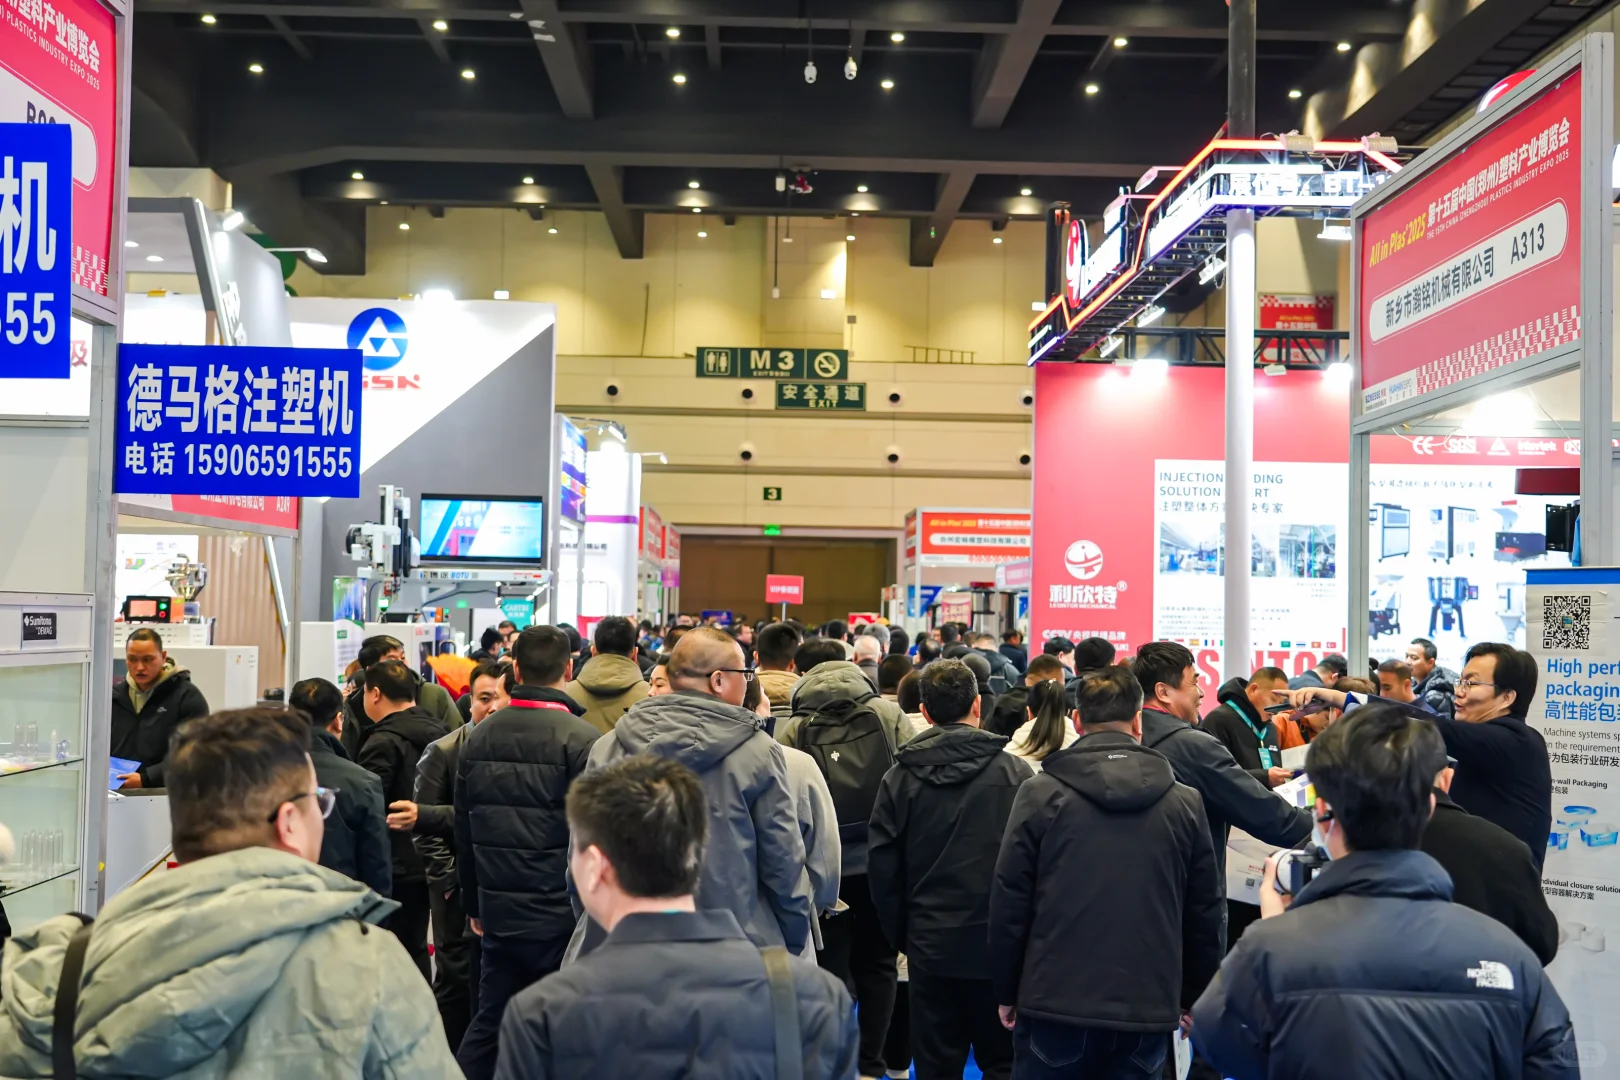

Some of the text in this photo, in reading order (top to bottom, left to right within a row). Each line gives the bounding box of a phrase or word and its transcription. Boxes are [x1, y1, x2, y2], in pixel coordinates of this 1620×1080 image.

[6, 0, 100, 73] 塑料产业博览会
[6, 10, 37, 43] PLASTICS
[38, 35, 68, 66] INDUSTRY
[70, 59, 85, 78] EXPO
[86, 72, 100, 91] 2025
[1489, 182, 1513, 203] PLASTICS
[1513, 167, 1539, 190] INDUSTRY
[1539, 157, 1555, 174] EXPO
[1555, 148, 1570, 165] 2025
[1370, 241, 1381, 268] All
[1381, 239, 1389, 261] in
[1385, 221, 1545, 329] 新乡市瀚铭机械有限公司 A313
[0, 291, 56, 346] 55
[750, 349, 795, 371] M 3
[126, 362, 354, 437] 德马格注塑机
[808, 398, 838, 408] EXIT
[124, 440, 353, 479] 电话 15906591555
[1159, 472, 1224, 483] INJECTION
[767, 488, 778, 500] 3
[1159, 486, 1221, 496] SOLUTION
[1049, 584, 1118, 604] 利欣特
[1547, 658, 1582, 678] High
[1545, 700, 1620, 722] 高性能包
[1543, 727, 1577, 738] Machine
[1578, 730, 1611, 741] systems
[1555, 741, 1568, 750] the
[1572, 779, 1608, 790] Packaging
[1542, 879, 1569, 888] ndividual
[1569, 881, 1595, 891] closure
